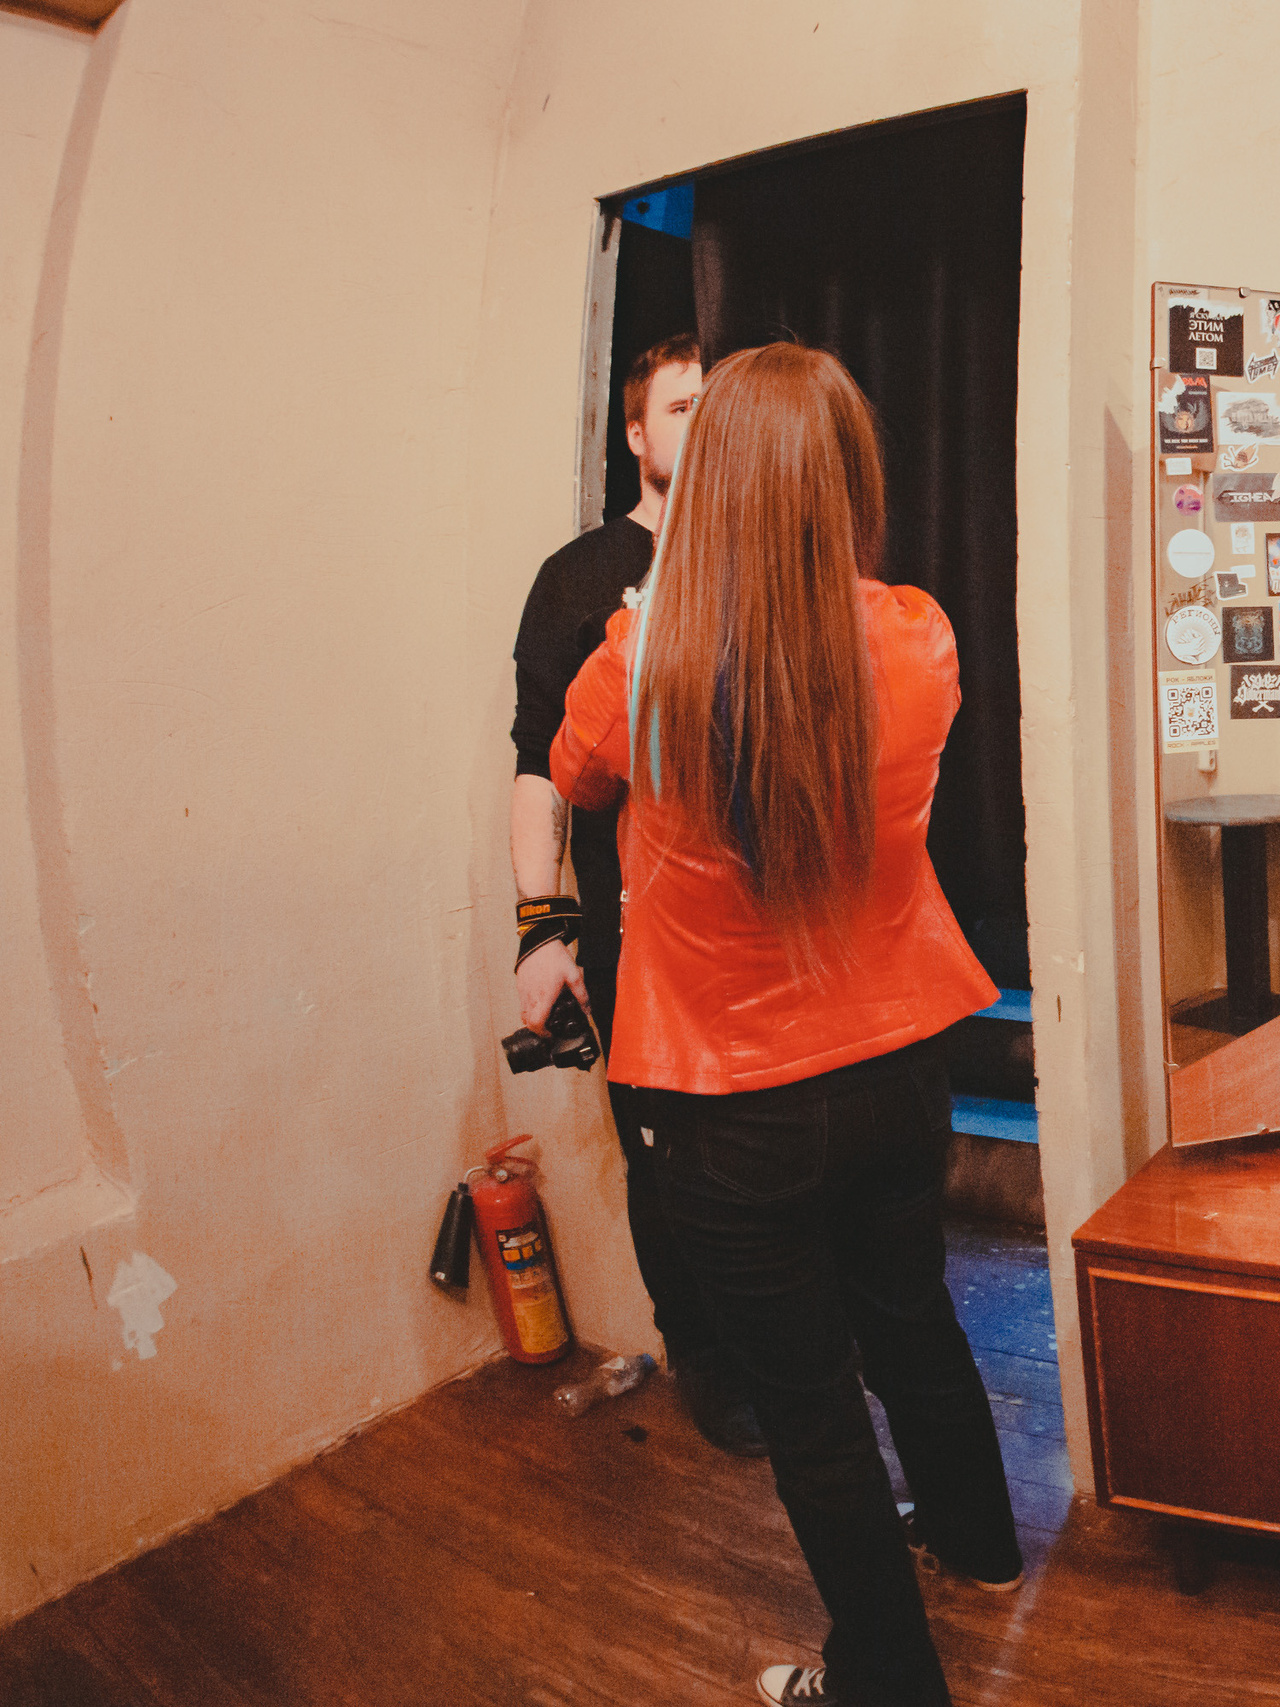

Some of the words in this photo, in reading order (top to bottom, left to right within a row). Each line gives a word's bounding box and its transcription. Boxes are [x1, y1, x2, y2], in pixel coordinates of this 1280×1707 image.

[1188, 320, 1224, 333] ЭТИМ
[1188, 331, 1224, 342] ЛЕТОМ
[519, 903, 551, 918] Nikon
